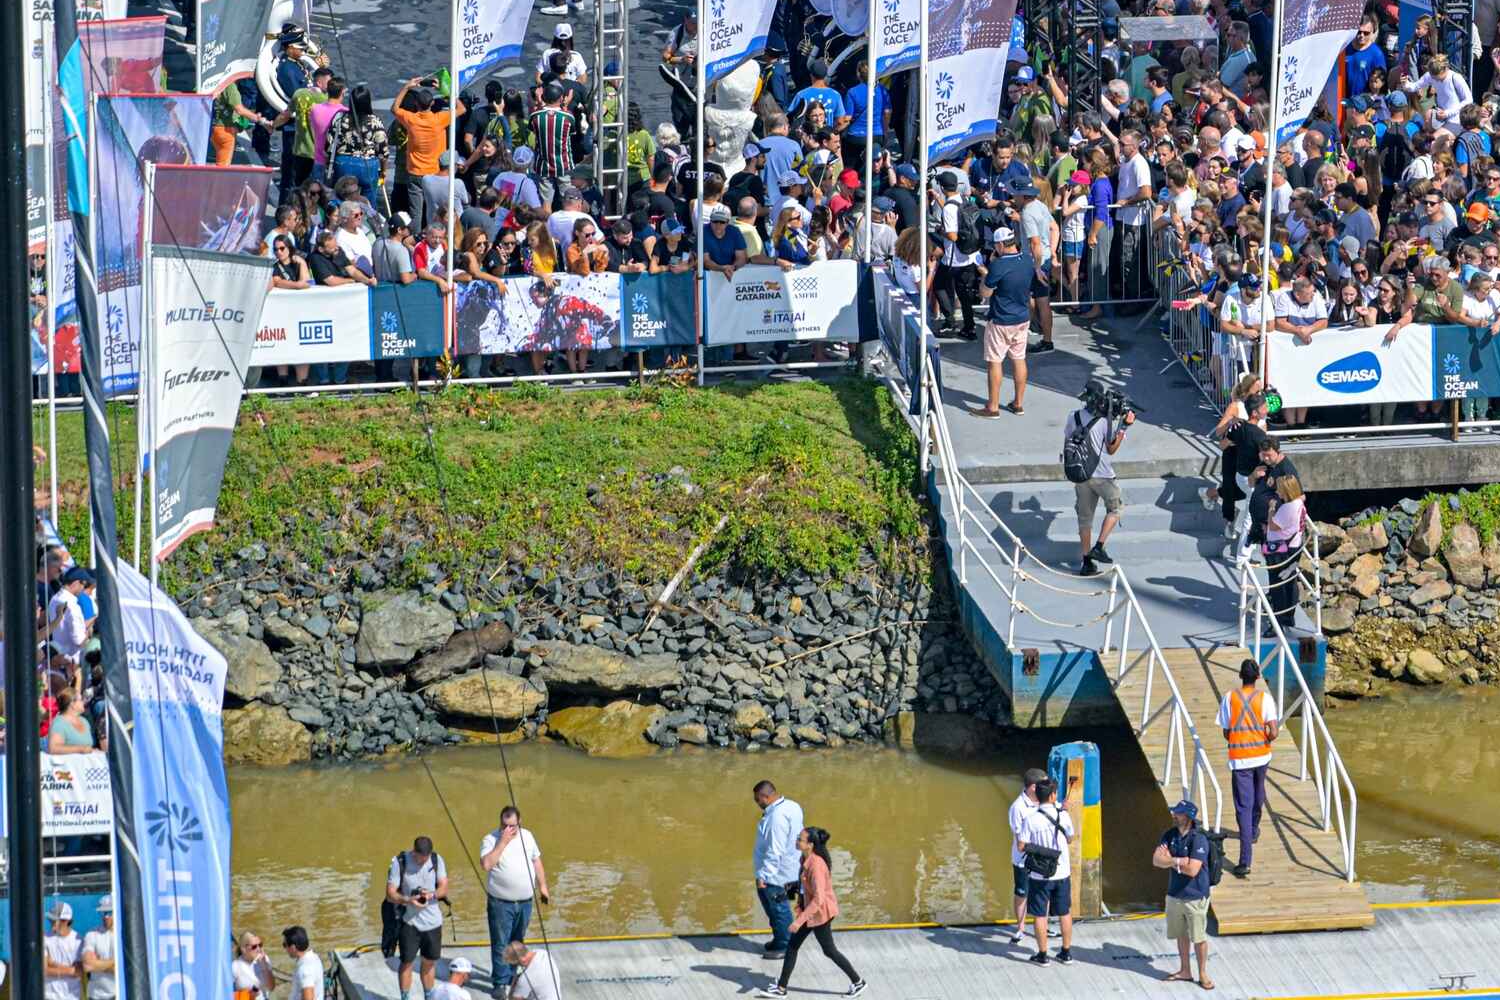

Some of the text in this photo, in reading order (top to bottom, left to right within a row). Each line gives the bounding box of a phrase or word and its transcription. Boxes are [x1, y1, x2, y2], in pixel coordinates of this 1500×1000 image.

[710, 18, 726, 31] THE
[884, 14, 900, 25] THE
[710, 23, 743, 42] OCEAN
[685, 170, 714, 180] STFF
[735, 286, 766, 295] SANTA
[735, 292, 783, 302] CATARINA
[632, 314, 650, 322] THE
[632, 320, 667, 330] OCEAN
[256, 327, 287, 342] MÂNIA
[382, 332, 398, 341] THE
[632, 329, 657, 338] RACE
[382, 339, 416, 349] OCEAN
[382, 347, 405, 356] RACE
[1320, 368, 1379, 384] SEMASA
[1444, 380, 1479, 390] OCEAN
[1444, 390, 1467, 399] RACE
